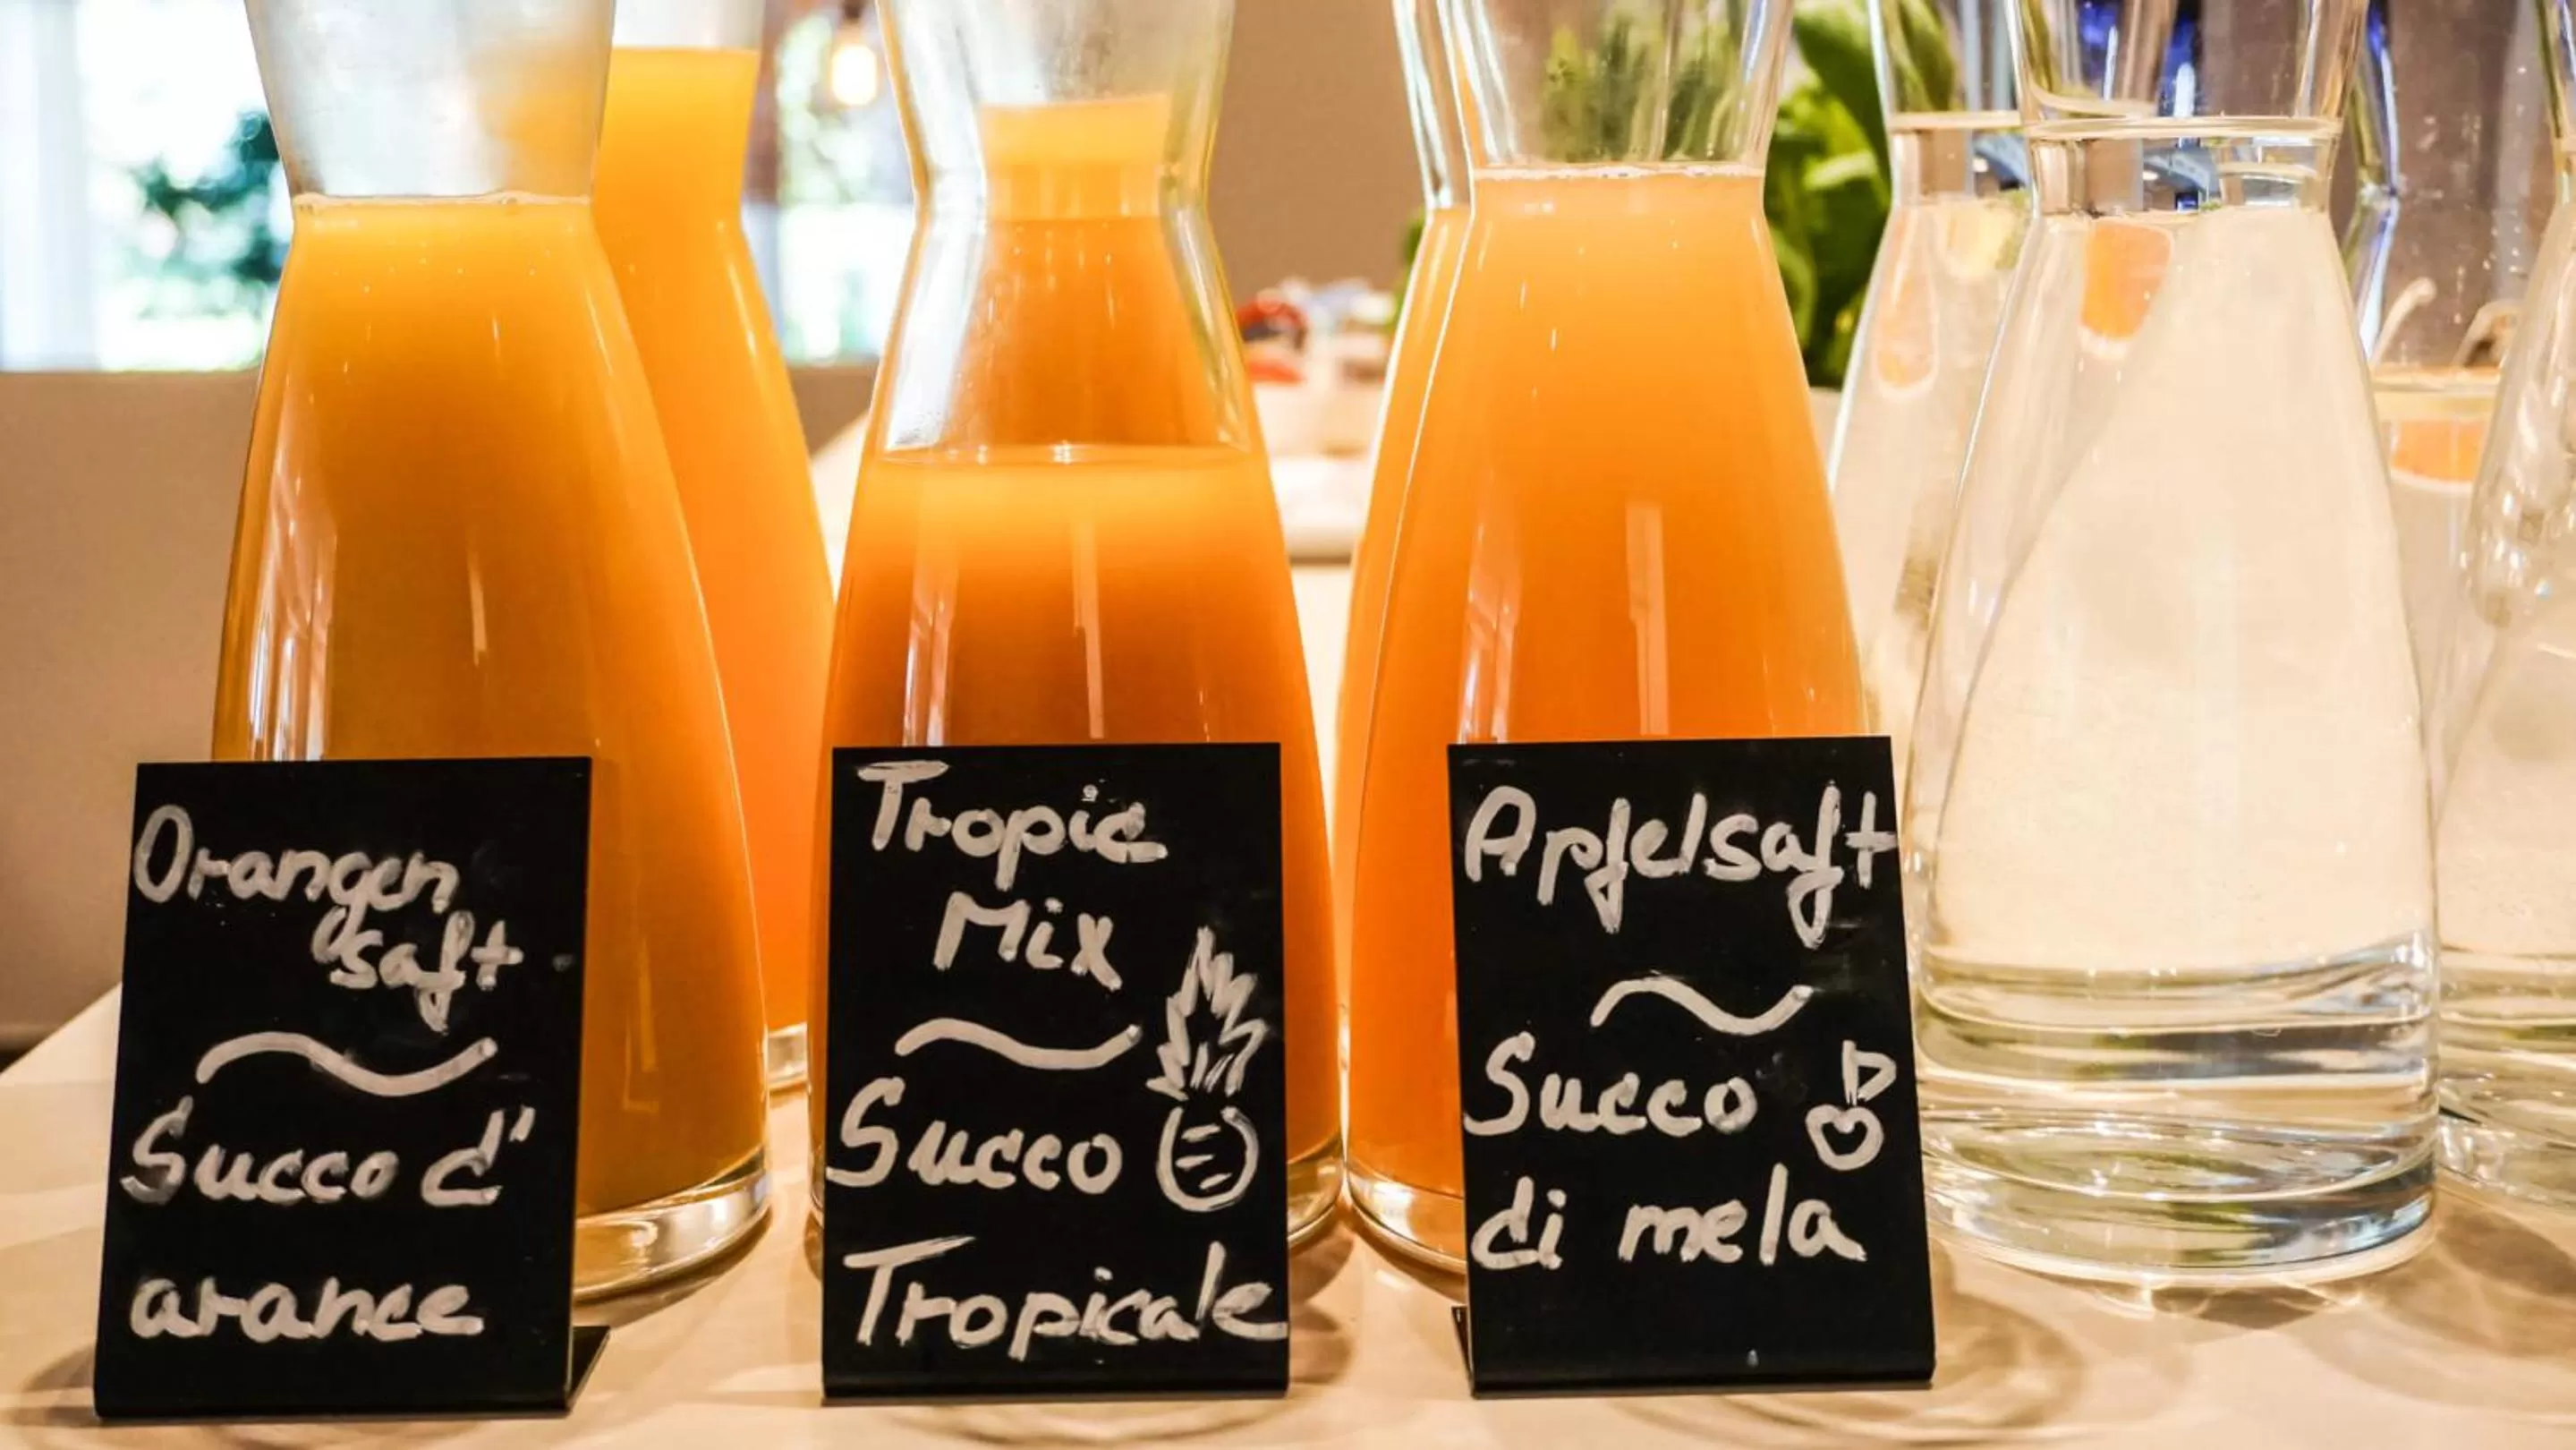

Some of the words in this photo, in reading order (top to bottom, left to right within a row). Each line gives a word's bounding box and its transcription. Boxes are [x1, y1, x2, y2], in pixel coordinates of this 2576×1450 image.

[132, 804, 459, 962] Orangen
[856, 760, 1169, 891] Tropic
[1464, 780, 1901, 949] Apfelsaft
[329, 909, 524, 1035] saft
[932, 891, 1123, 992] Mix
[826, 1076, 1123, 1194] Succo
[1464, 1030, 1756, 1138] Succo
[121, 1094, 400, 1204] Succo
[420, 1105, 536, 1207] d'
[1471, 1175, 1568, 1271] di
[1618, 1163, 1867, 1267] mela
[129, 1276, 485, 1343] arance
[844, 1234, 1288, 1362] Tropicale
